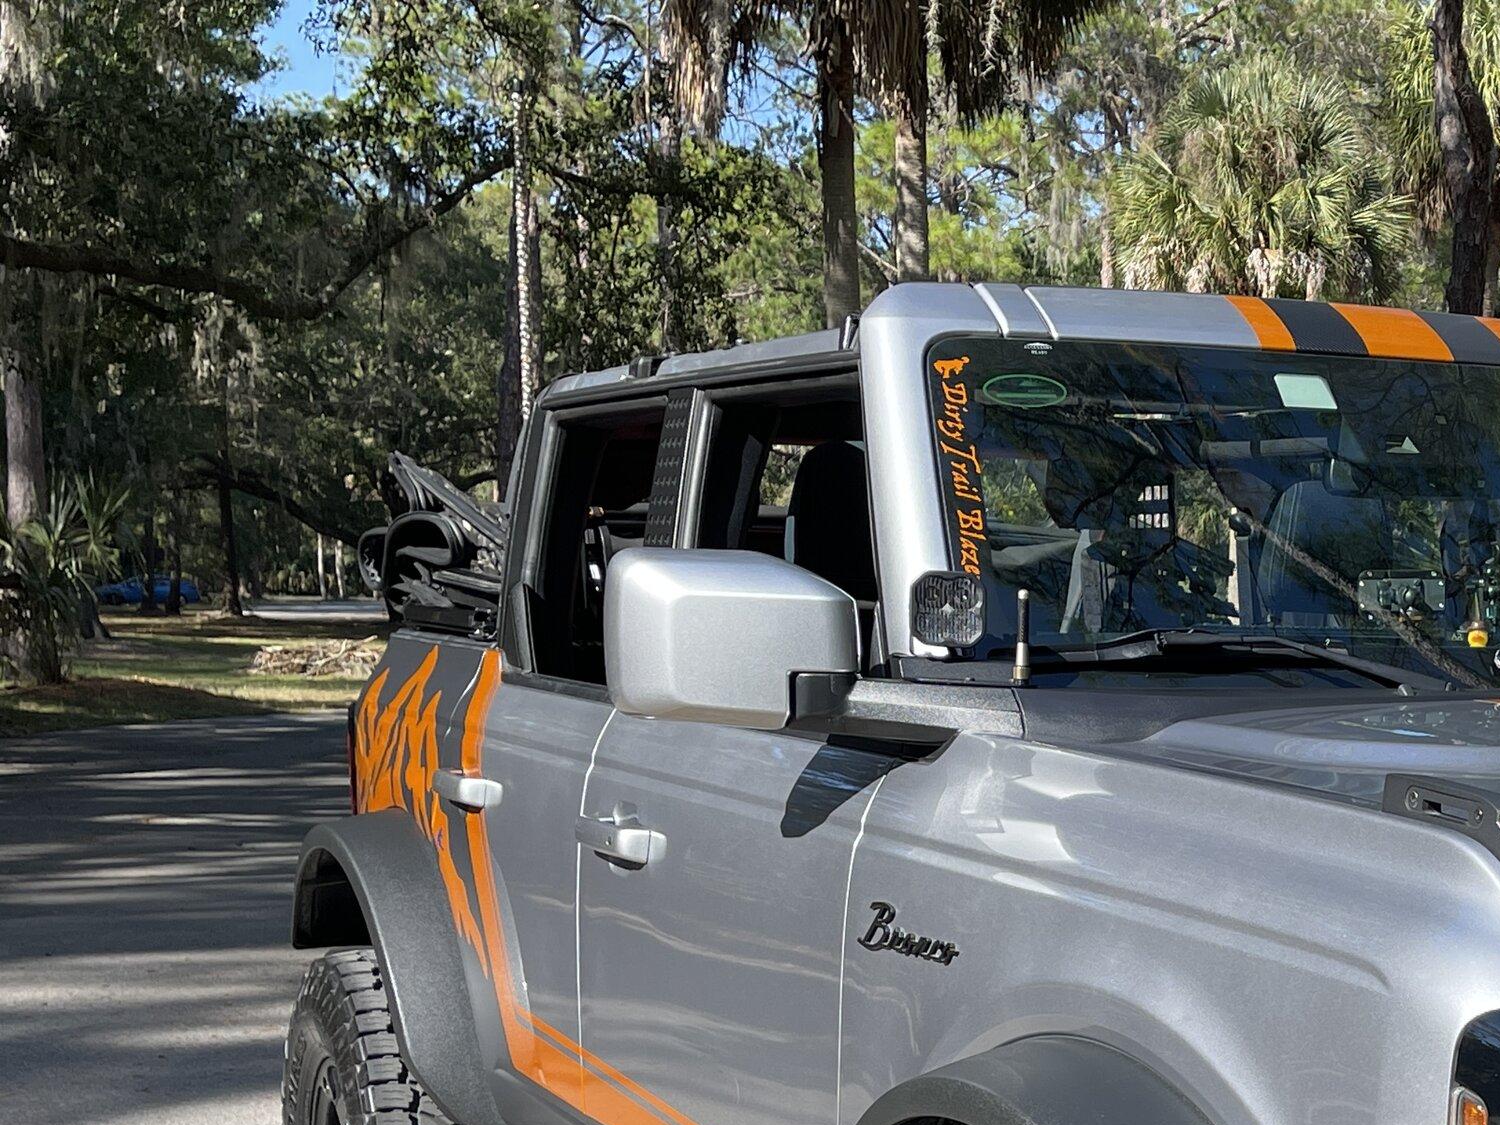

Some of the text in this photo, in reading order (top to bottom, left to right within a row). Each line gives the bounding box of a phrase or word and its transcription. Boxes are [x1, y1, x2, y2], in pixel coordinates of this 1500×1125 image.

[937, 381, 987, 580] Dirty Trail Blaze
[857, 901, 960, 966] Bronco
